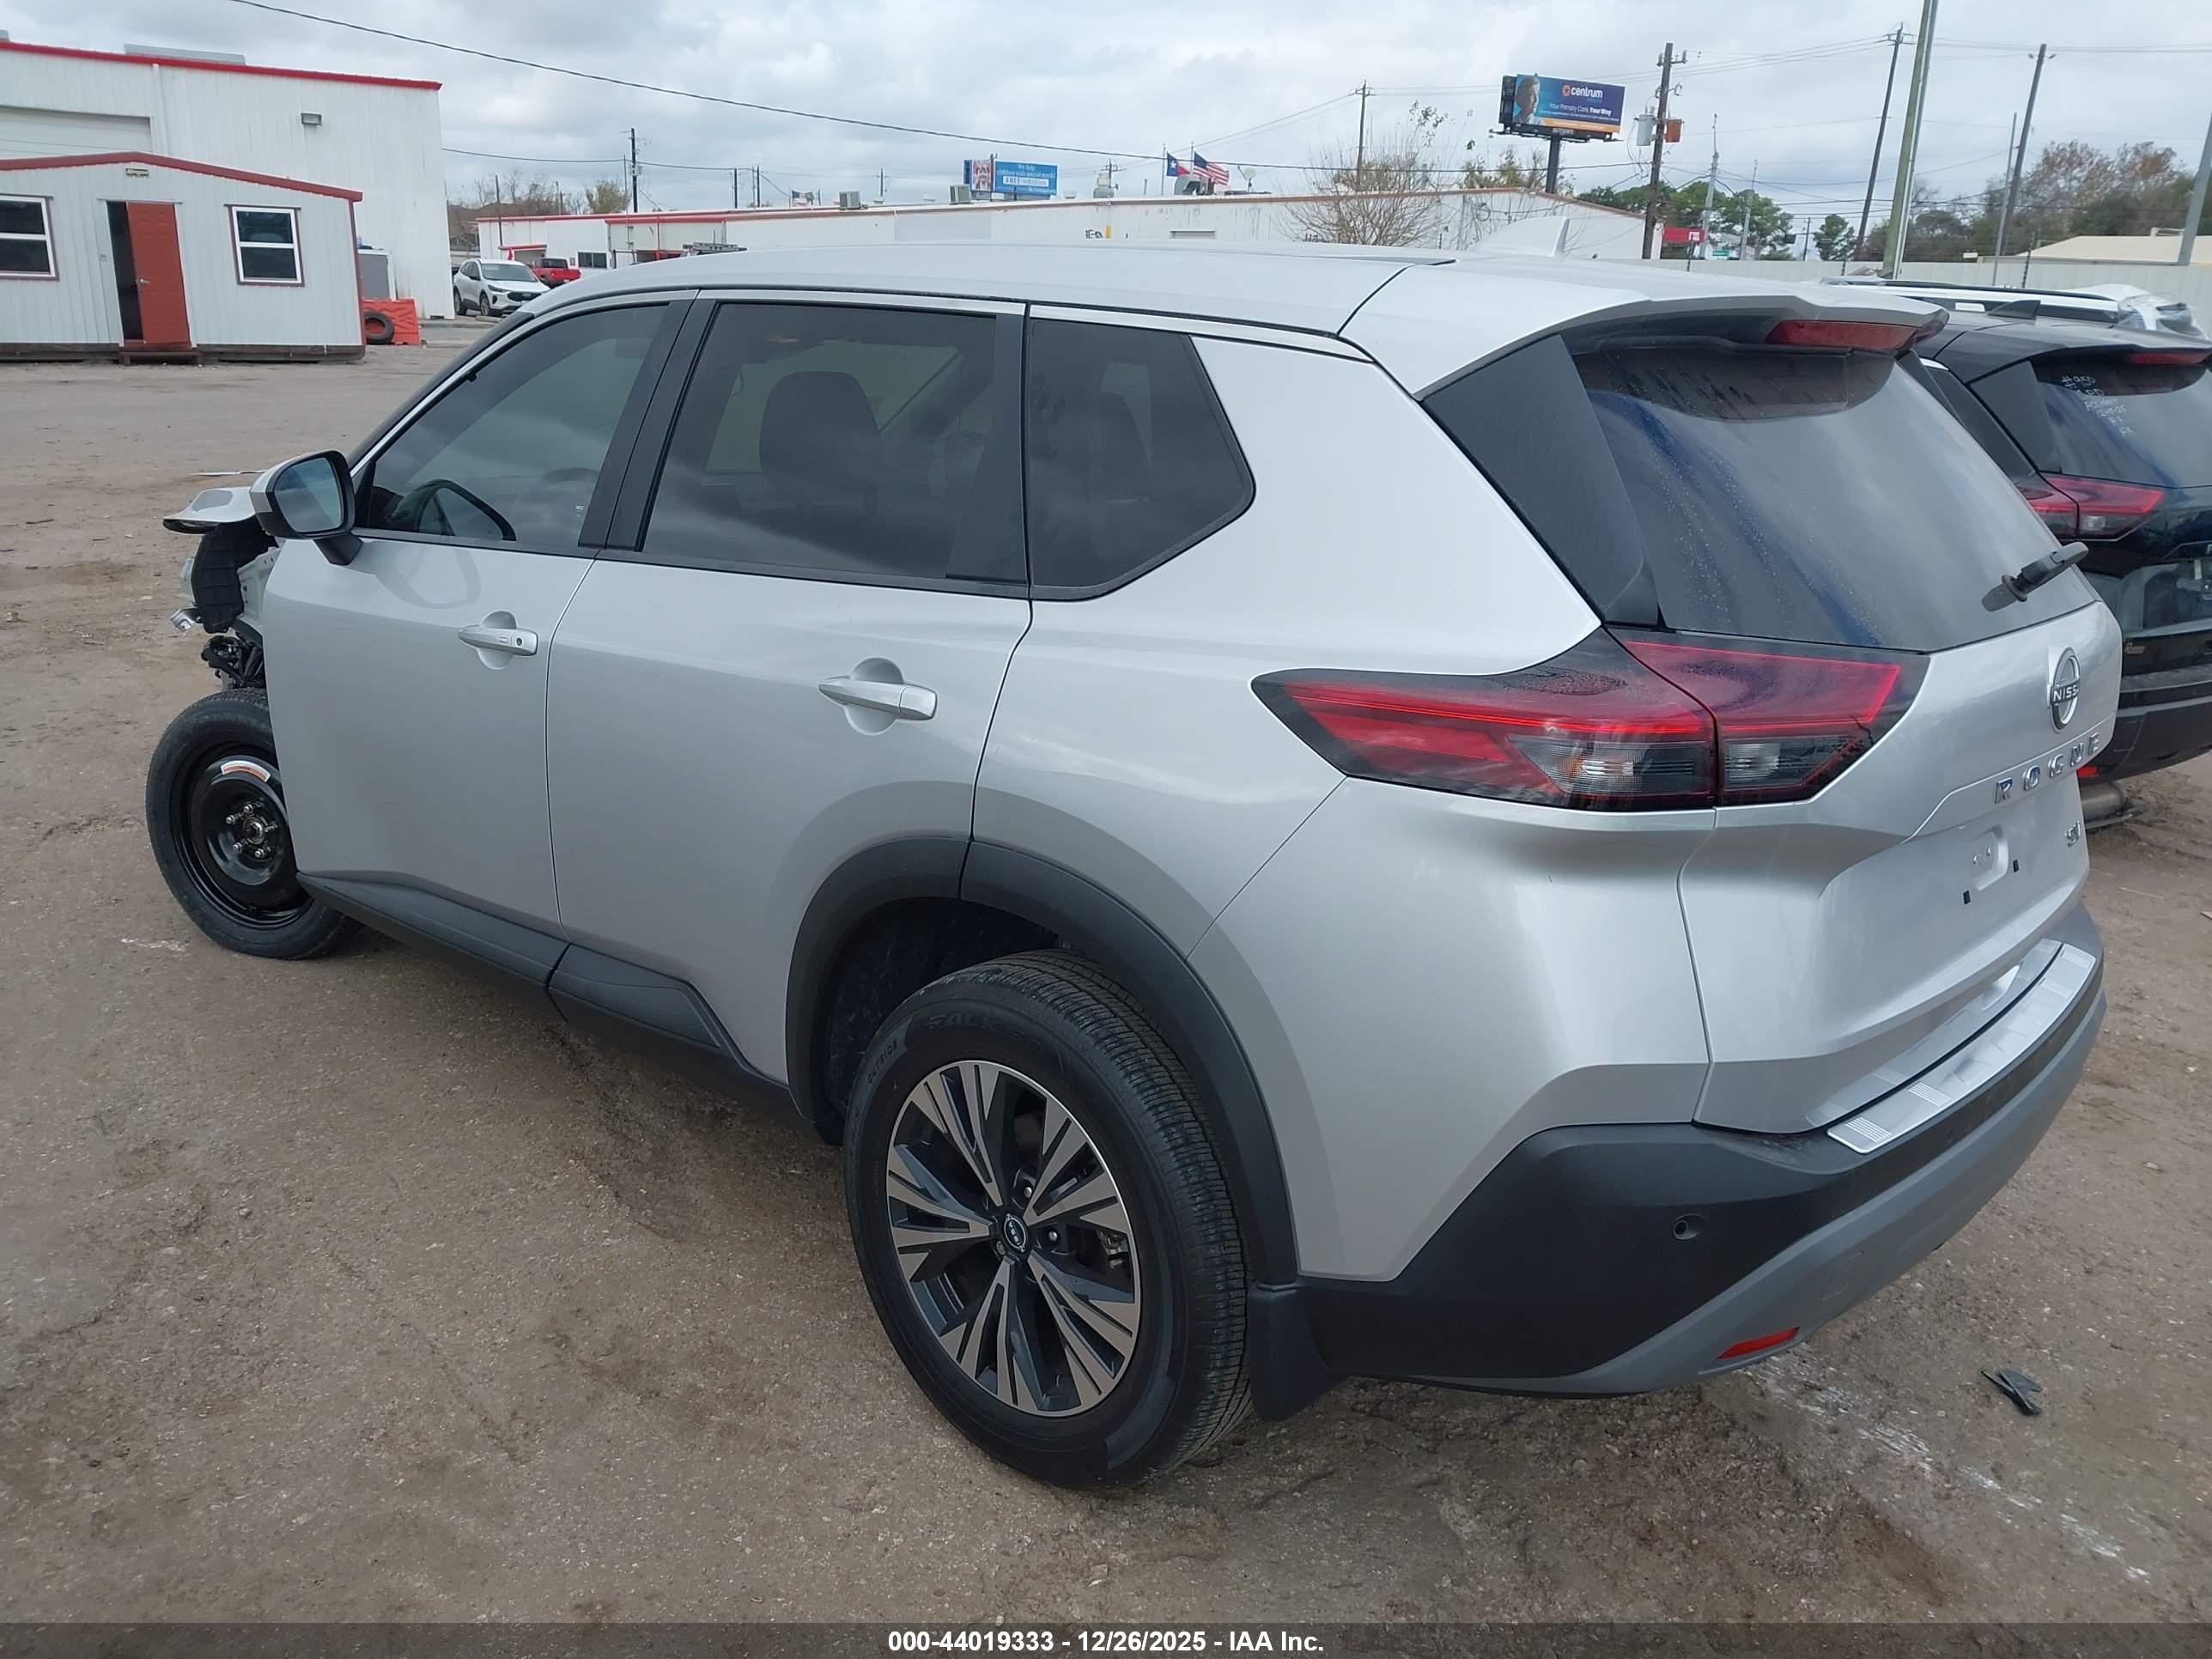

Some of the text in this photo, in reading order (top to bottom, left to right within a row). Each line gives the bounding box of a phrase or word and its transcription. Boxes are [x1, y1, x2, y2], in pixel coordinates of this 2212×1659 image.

[1571, 86, 1603, 99] centrum
[2053, 684, 2080, 702] NISS
[1994, 732, 2100, 805] ROGUE
[867, 1040, 898, 1084] OUTSIDE
